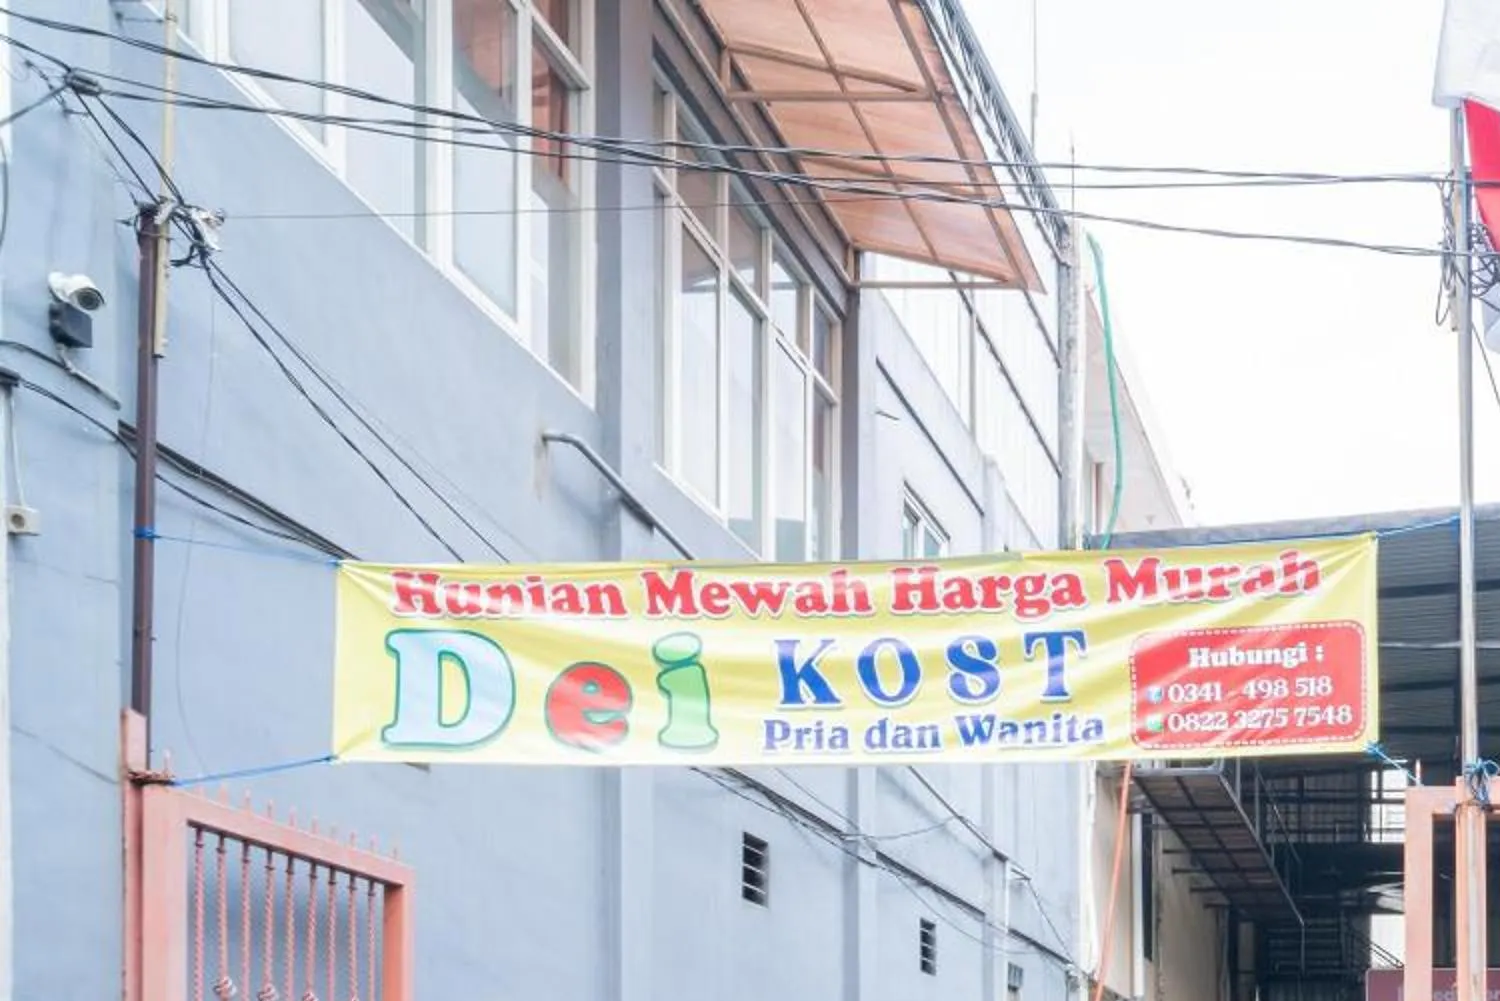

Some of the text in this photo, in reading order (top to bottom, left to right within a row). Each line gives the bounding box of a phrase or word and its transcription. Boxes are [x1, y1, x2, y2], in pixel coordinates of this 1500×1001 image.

[391, 550, 1321, 618] Hunian Mewah Harga Murah
[774, 630, 1086, 707] KOST
[1188, 642, 1309, 668] Hubungi
[381, 629, 719, 752] Dei
[1167, 681, 1222, 703] 0341
[1243, 678, 1289, 699] 498
[1295, 675, 1333, 697] 518
[763, 713, 1105, 752] Pria dan Wanita
[1167, 704, 1353, 732] 0822 3275 7548
